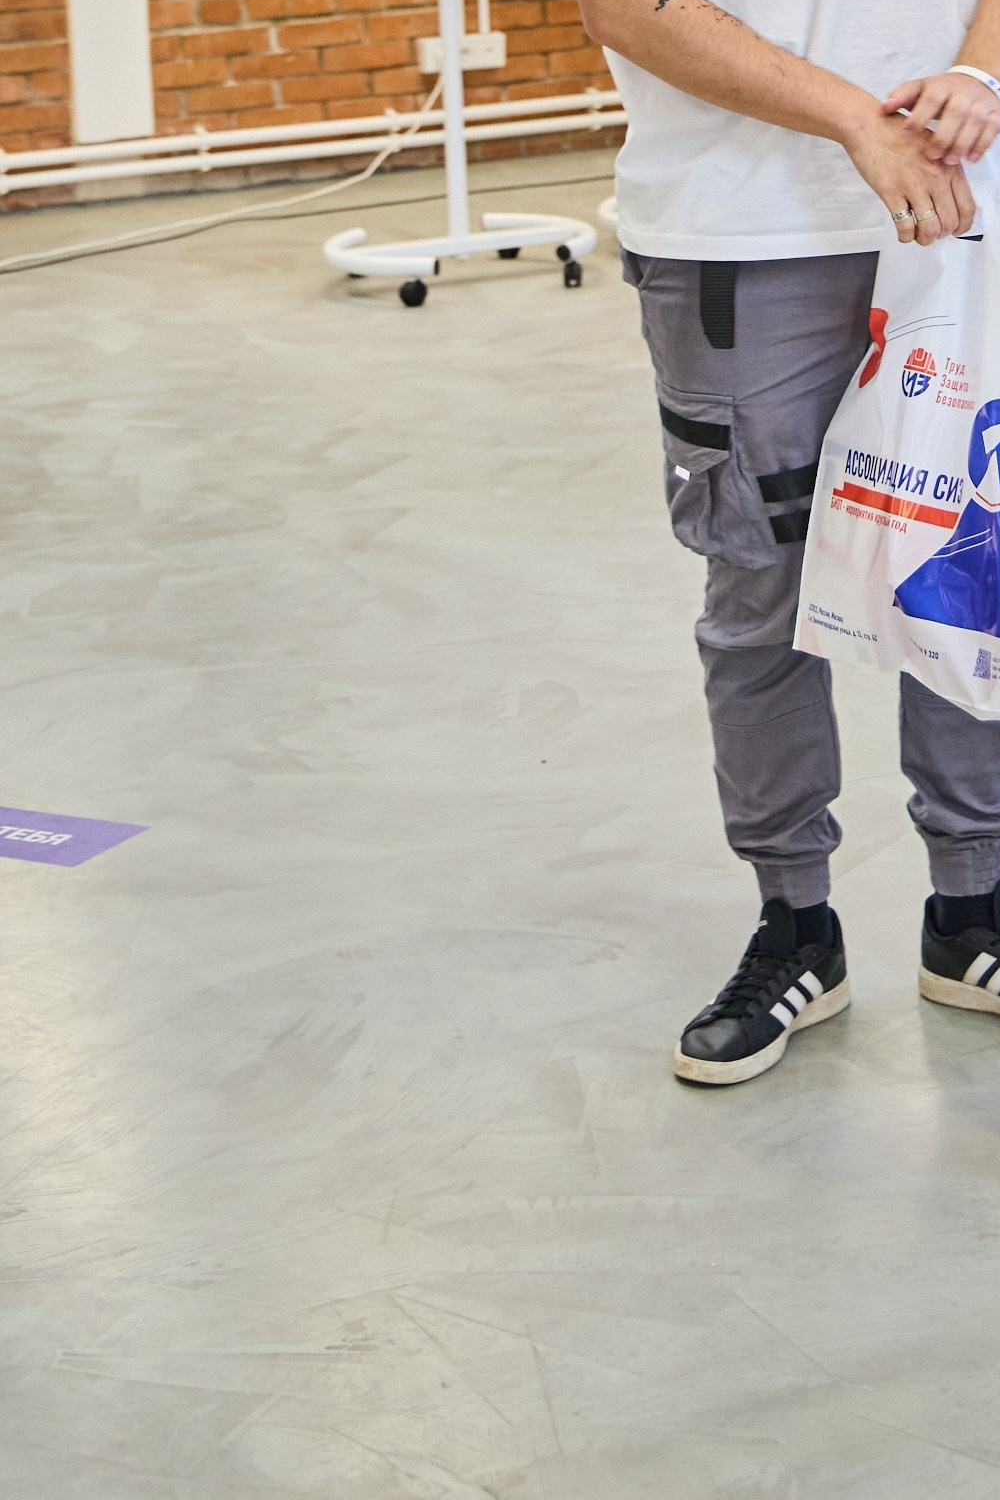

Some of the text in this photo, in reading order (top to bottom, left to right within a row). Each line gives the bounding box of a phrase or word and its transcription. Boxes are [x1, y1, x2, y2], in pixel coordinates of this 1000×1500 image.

[945, 357, 966, 376] Труд
[844, 449, 965, 504] АССОЦИАЦИЯ СИЗ
[891, 519, 908, 534] год
